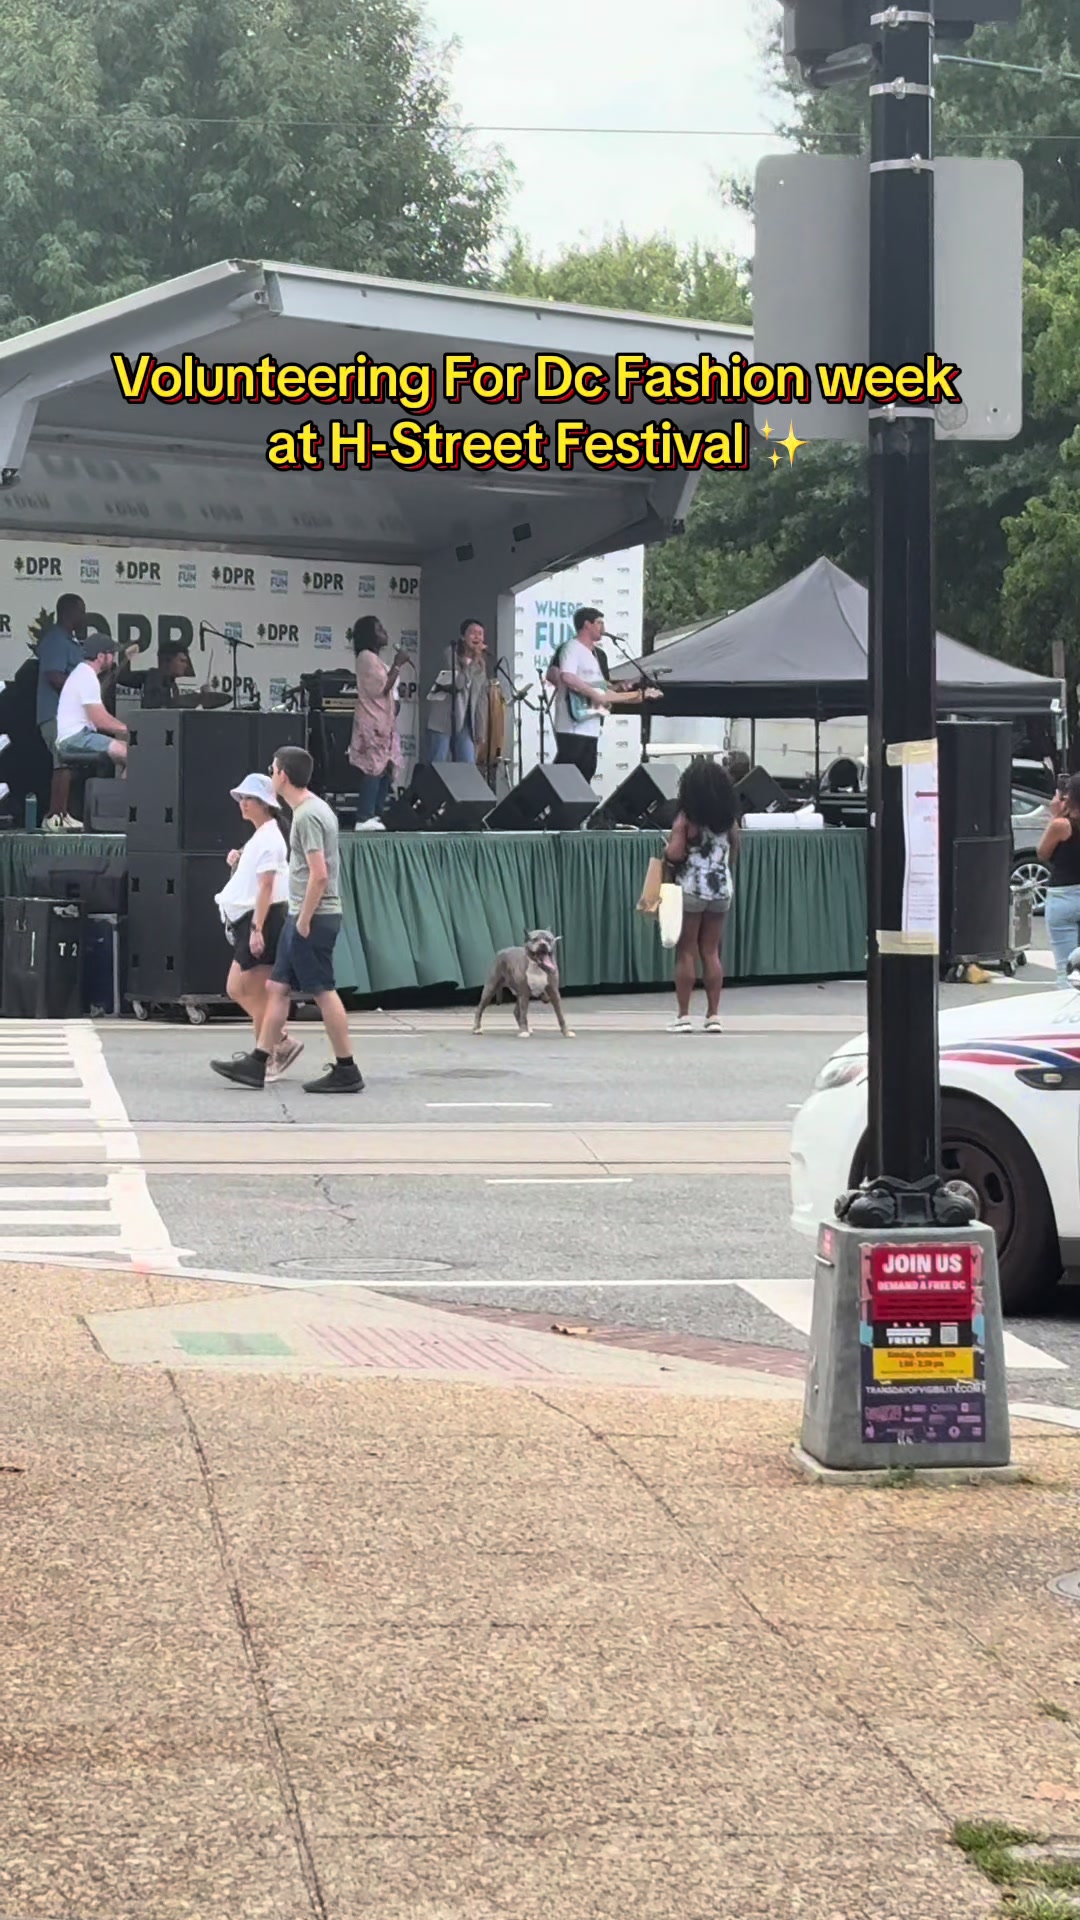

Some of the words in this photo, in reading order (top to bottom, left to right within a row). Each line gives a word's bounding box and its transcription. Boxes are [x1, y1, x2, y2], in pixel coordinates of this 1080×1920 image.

[26, 556, 62, 575] DPR
[127, 561, 160, 580] DPR
[222, 566, 255, 586] DPR
[313, 572, 343, 591] DPR
[399, 577, 419, 595] DP
[267, 623, 299, 642] DPR
[58, 943, 66, 956] T
[71, 943, 78, 956] 2
[882, 1253, 932, 1274] JOIN
[935, 1253, 963, 1273] US
[919, 1280, 926, 1290] A
